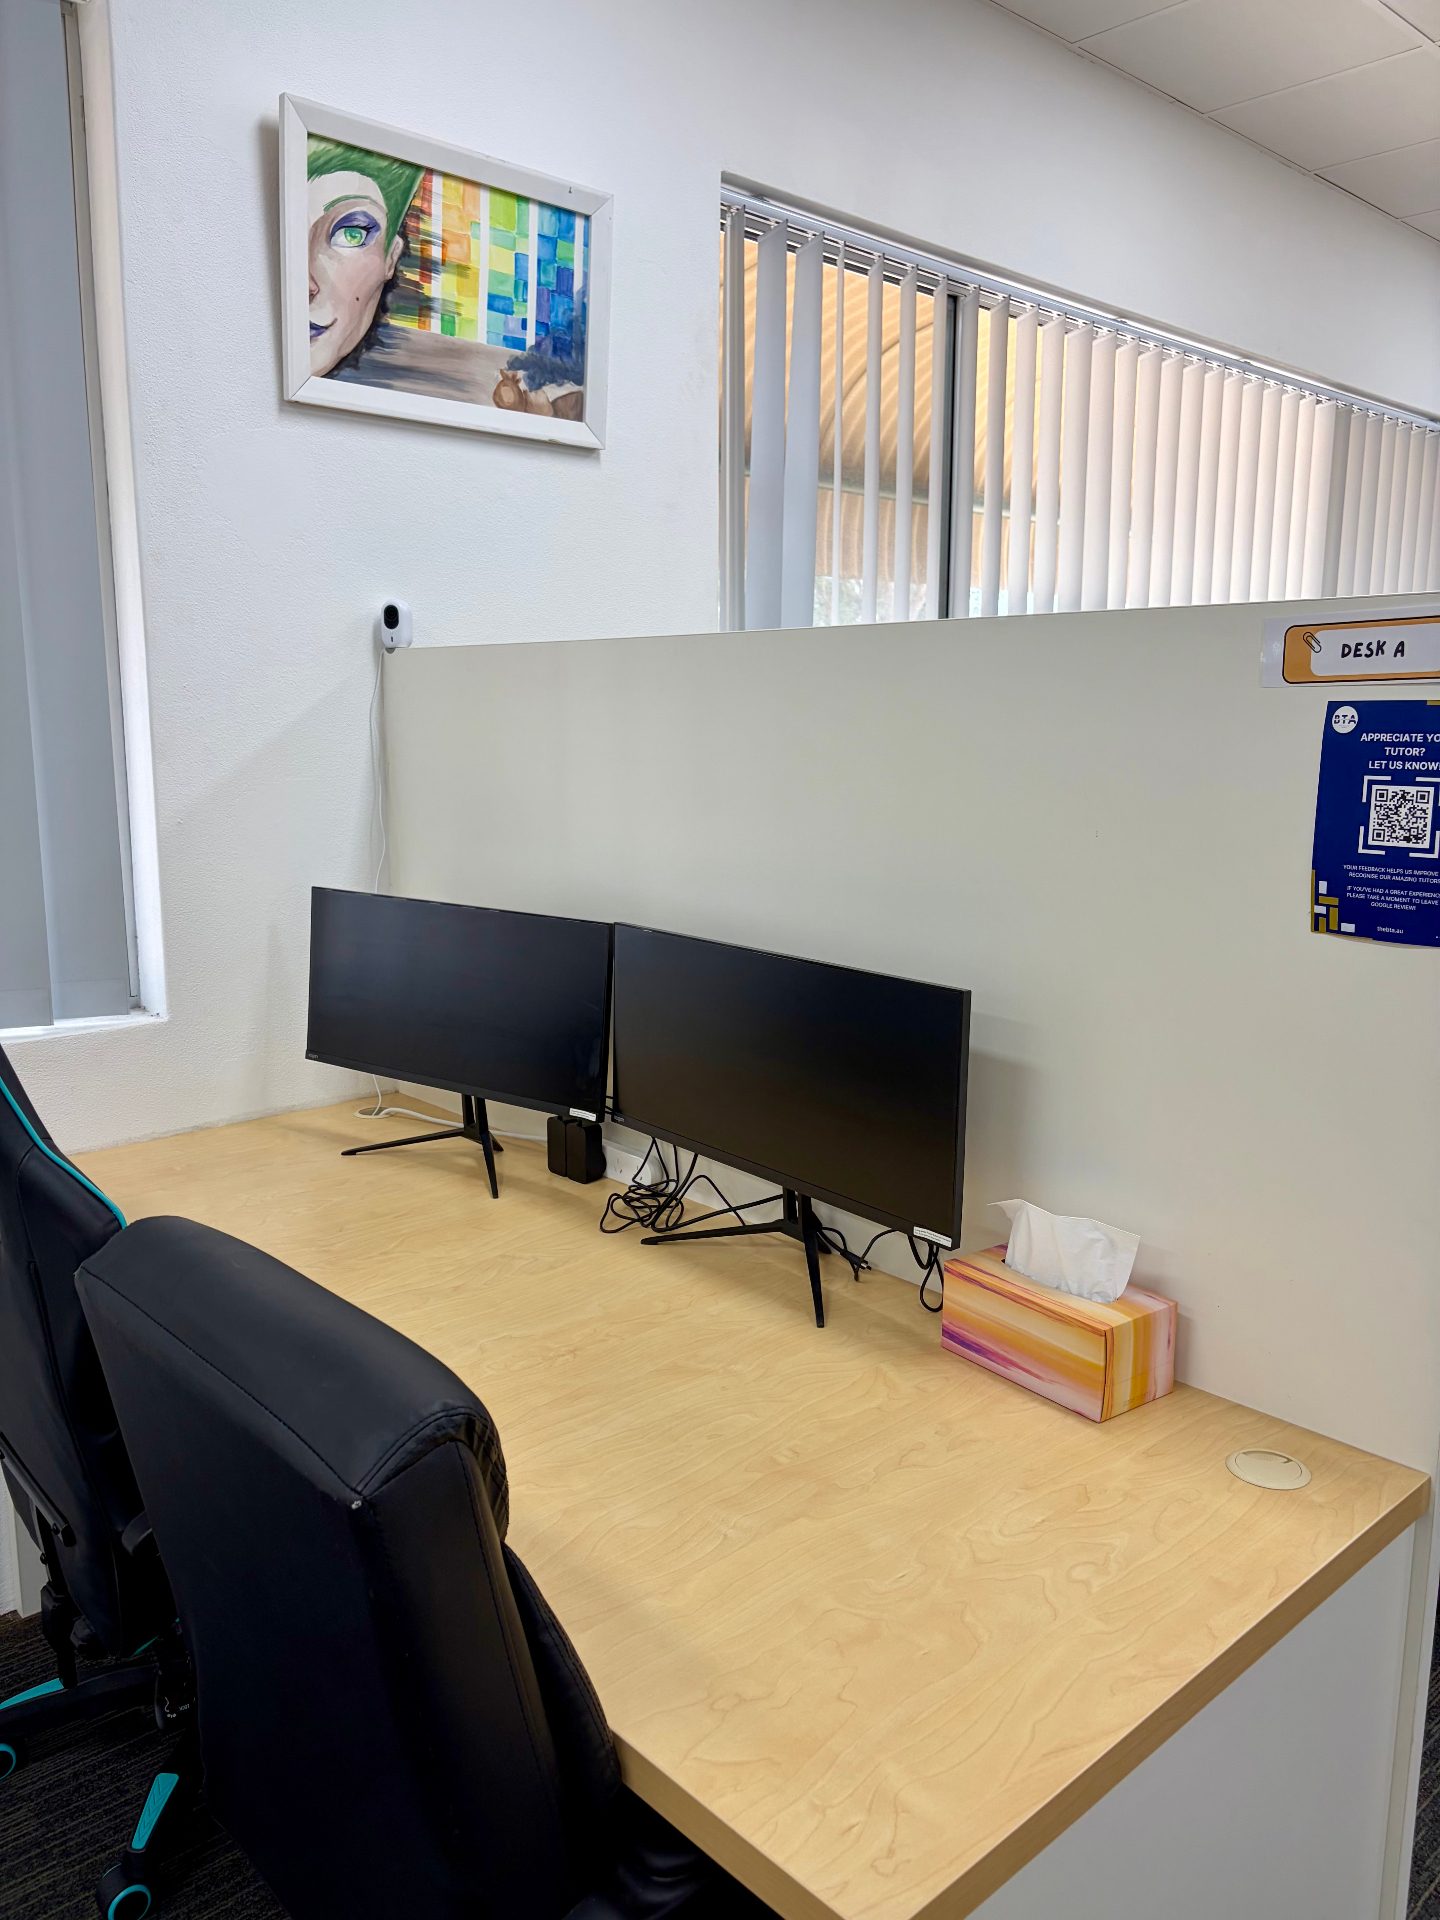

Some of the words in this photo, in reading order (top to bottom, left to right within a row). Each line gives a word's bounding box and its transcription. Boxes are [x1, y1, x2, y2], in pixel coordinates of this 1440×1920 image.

[1341, 640, 1386, 658] DESK
[1393, 641, 1405, 658] A
[1334, 715, 1356, 724] BTA
[1360, 733, 1424, 742] APPRECIATE
[1384, 747, 1426, 756] TUTOR?
[1368, 760, 1387, 769] LET
[1388, 761, 1403, 769] US
[1348, 871, 1379, 879] RECOGNISE
[1413, 869, 1439, 877] IMPROVE
[1370, 901, 1393, 909] GOOGLE
